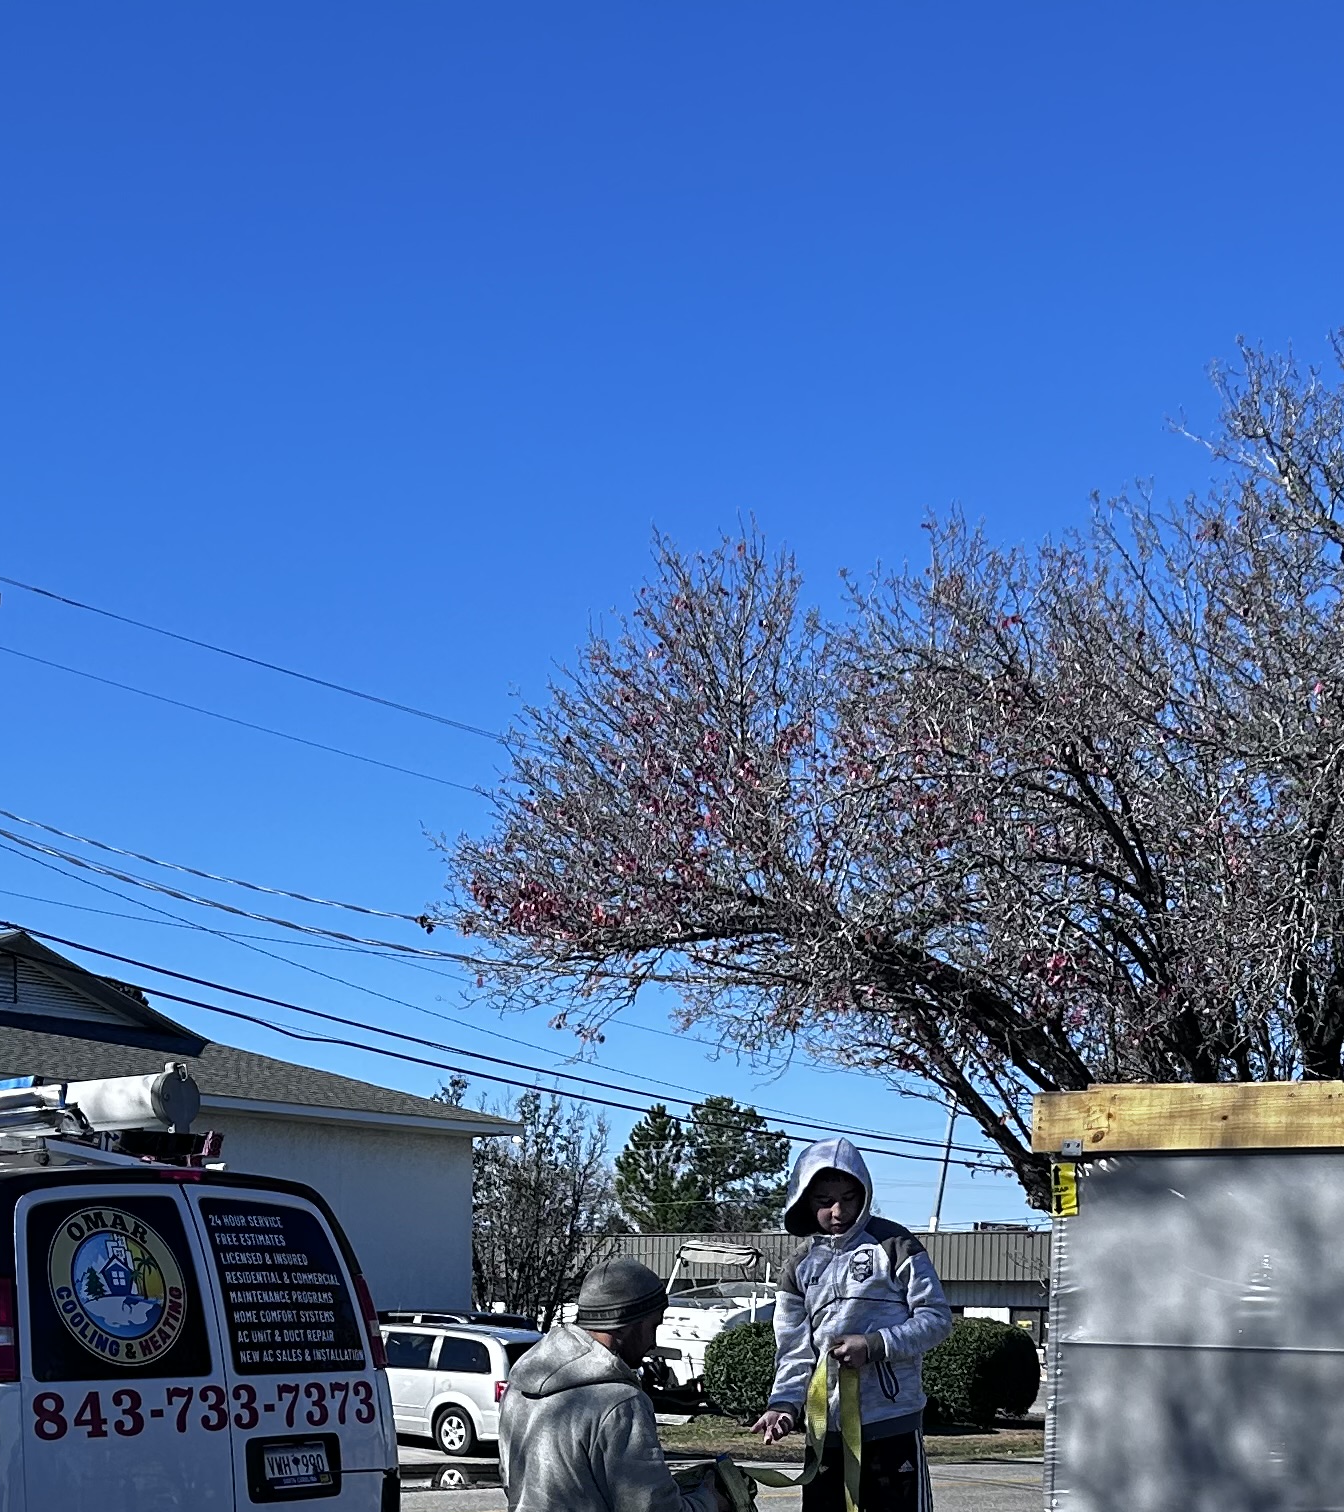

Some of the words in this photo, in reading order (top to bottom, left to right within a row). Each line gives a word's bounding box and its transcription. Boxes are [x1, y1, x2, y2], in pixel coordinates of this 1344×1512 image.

[67, 1211, 147, 1244] OMAR
[209, 1215, 222, 1226] 24
[222, 1215, 246, 1226] HOUR
[248, 1216, 283, 1228] SERVICE
[215, 1233, 239, 1245] FREE
[239, 1234, 286, 1246] ESTIMATES
[220, 1252, 262, 1264] LICENSED
[265, 1253, 272, 1264] &
[273, 1253, 308, 1265] INSURED
[225, 1271, 282, 1284] RESIDENTIAL
[283, 1272, 290, 1283] &
[291, 1273, 340, 1285] COMMERCIAL
[229, 1291, 291, 1303] MAINTENANCE
[292, 1291, 333, 1303] PROGRAMS
[57, 1286, 121, 1357] COOLING
[125, 1343, 136, 1359] &
[139, 1286, 183, 1357] HEATING
[234, 1311, 258, 1323] HOME
[260, 1311, 297, 1323] COMFORT
[300, 1311, 335, 1322] SYSTEMS
[238, 1331, 250, 1342] AC
[252, 1331, 272, 1342] UNIT
[274, 1331, 281, 1342] &
[284, 1330, 305, 1342] DUCT
[307, 1330, 334, 1342] REPAIR
[240, 1350, 259, 1363] NEW
[263, 1350, 274, 1362] AC
[277, 1349, 302, 1361] SALES
[305, 1349, 311, 1361] &
[33, 1381, 376, 1441] 843-733-7373
